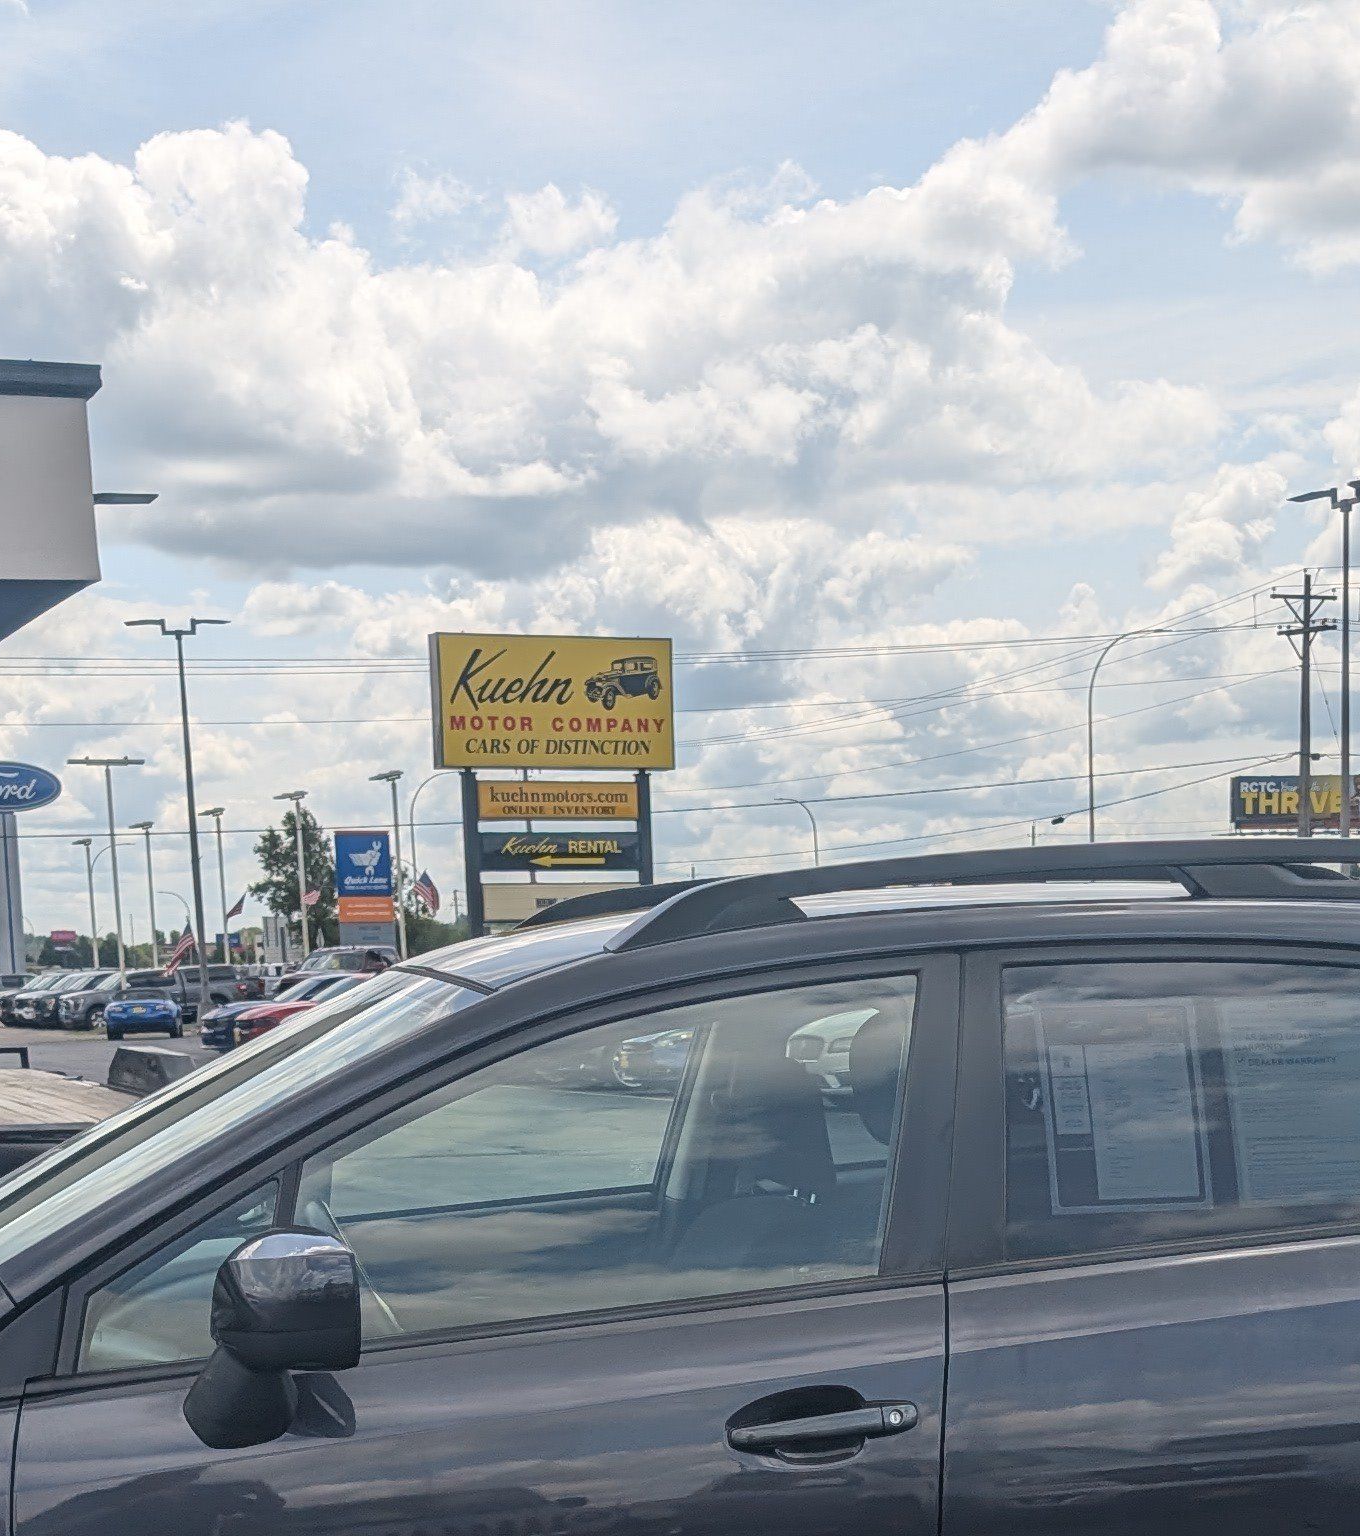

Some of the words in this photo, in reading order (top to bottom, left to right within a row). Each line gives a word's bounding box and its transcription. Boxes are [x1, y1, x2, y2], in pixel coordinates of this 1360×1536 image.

[449, 648, 574, 712] Kuehn
[449, 715, 534, 732] MOTOR
[551, 717, 666, 734] COMPANY
[465, 738, 511, 755] CARS
[517, 738, 540, 755] OF
[545, 739, 652, 756] DISTINCTION
[489, 786, 628, 804] kuehnmotors.com
[1240, 791, 1342, 815] THRVE
[501, 805, 546, 815] ONLINE
[552, 805, 617, 816] INVENTORY
[500, 836, 559, 856] Kuehn
[567, 840, 623, 854] RENTAL
